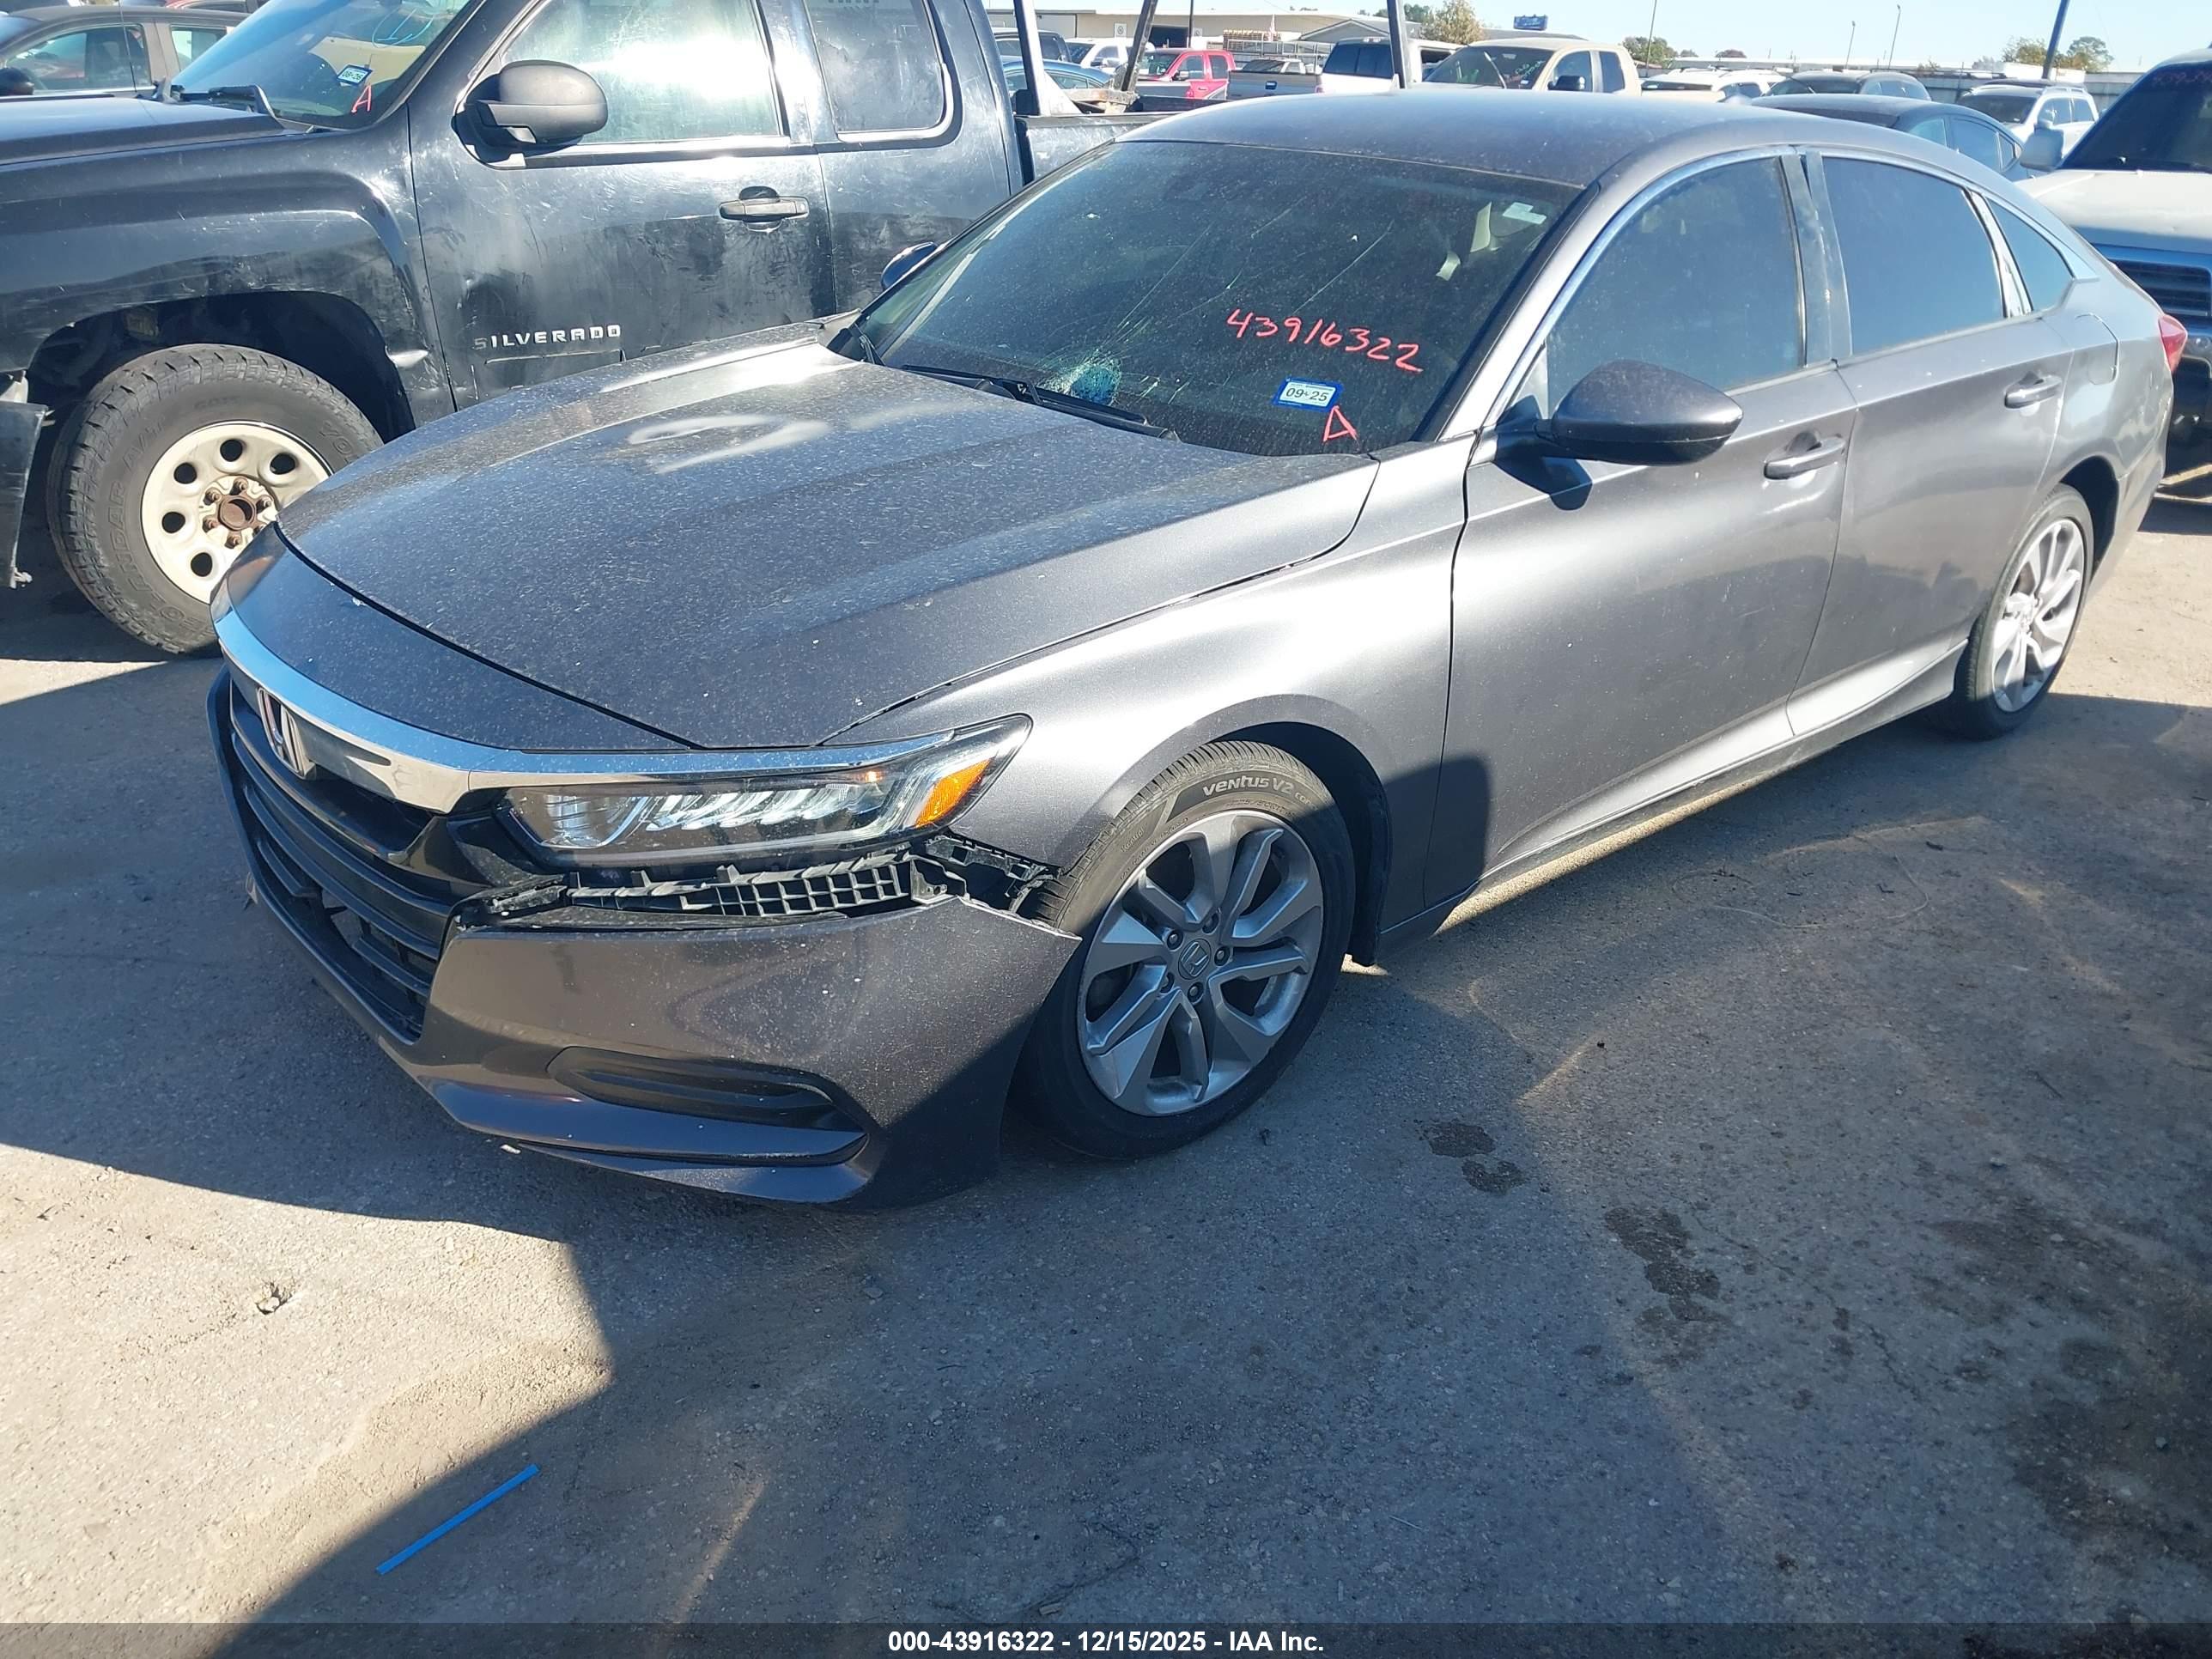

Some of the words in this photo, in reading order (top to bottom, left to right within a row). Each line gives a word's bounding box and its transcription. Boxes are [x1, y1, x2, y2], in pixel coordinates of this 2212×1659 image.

[351, 84, 372, 112] A
[473, 325, 621, 349] SILVERADO
[1226, 309, 1424, 373] 43916322
[1273, 777, 1295, 795] V2
